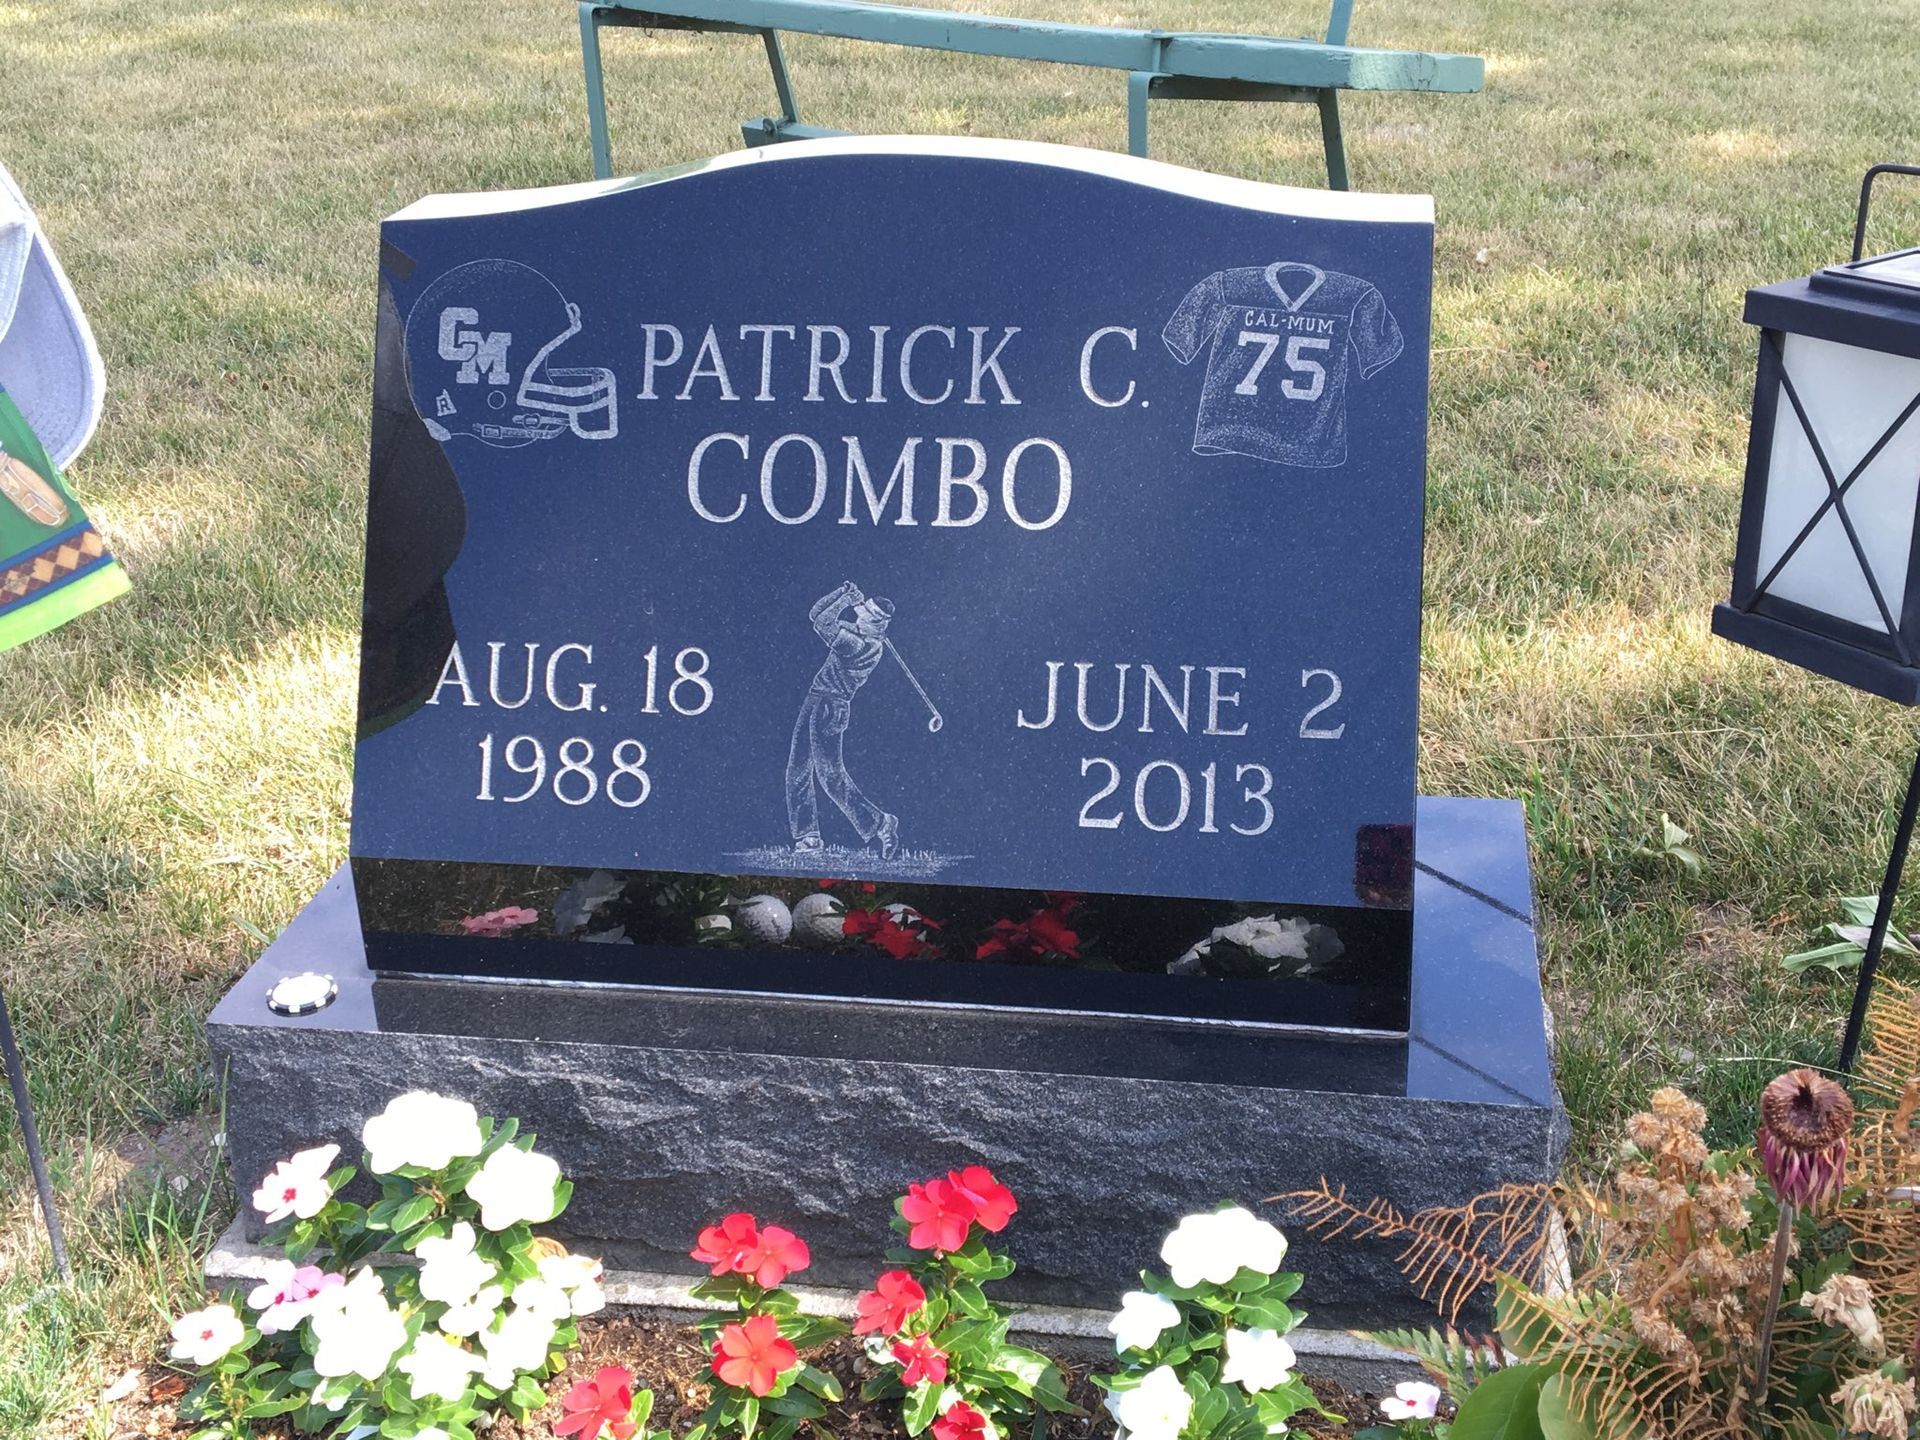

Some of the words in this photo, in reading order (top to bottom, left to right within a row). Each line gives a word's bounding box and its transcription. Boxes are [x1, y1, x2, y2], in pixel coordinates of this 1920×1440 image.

[1245, 310, 1335, 335] CAL-MUM
[636, 323, 1022, 405] PATRICK
[1080, 325, 1150, 408] C.
[1234, 330, 1330, 402] 75
[687, 431, 1073, 531] COMBO
[425, 640, 609, 712] AUG.
[641, 645, 714, 716] 18
[1017, 660, 1249, 736] JUNE
[1299, 668, 1346, 740] 2
[476, 733, 652, 808] 1988
[1078, 757, 1275, 836] 2013
